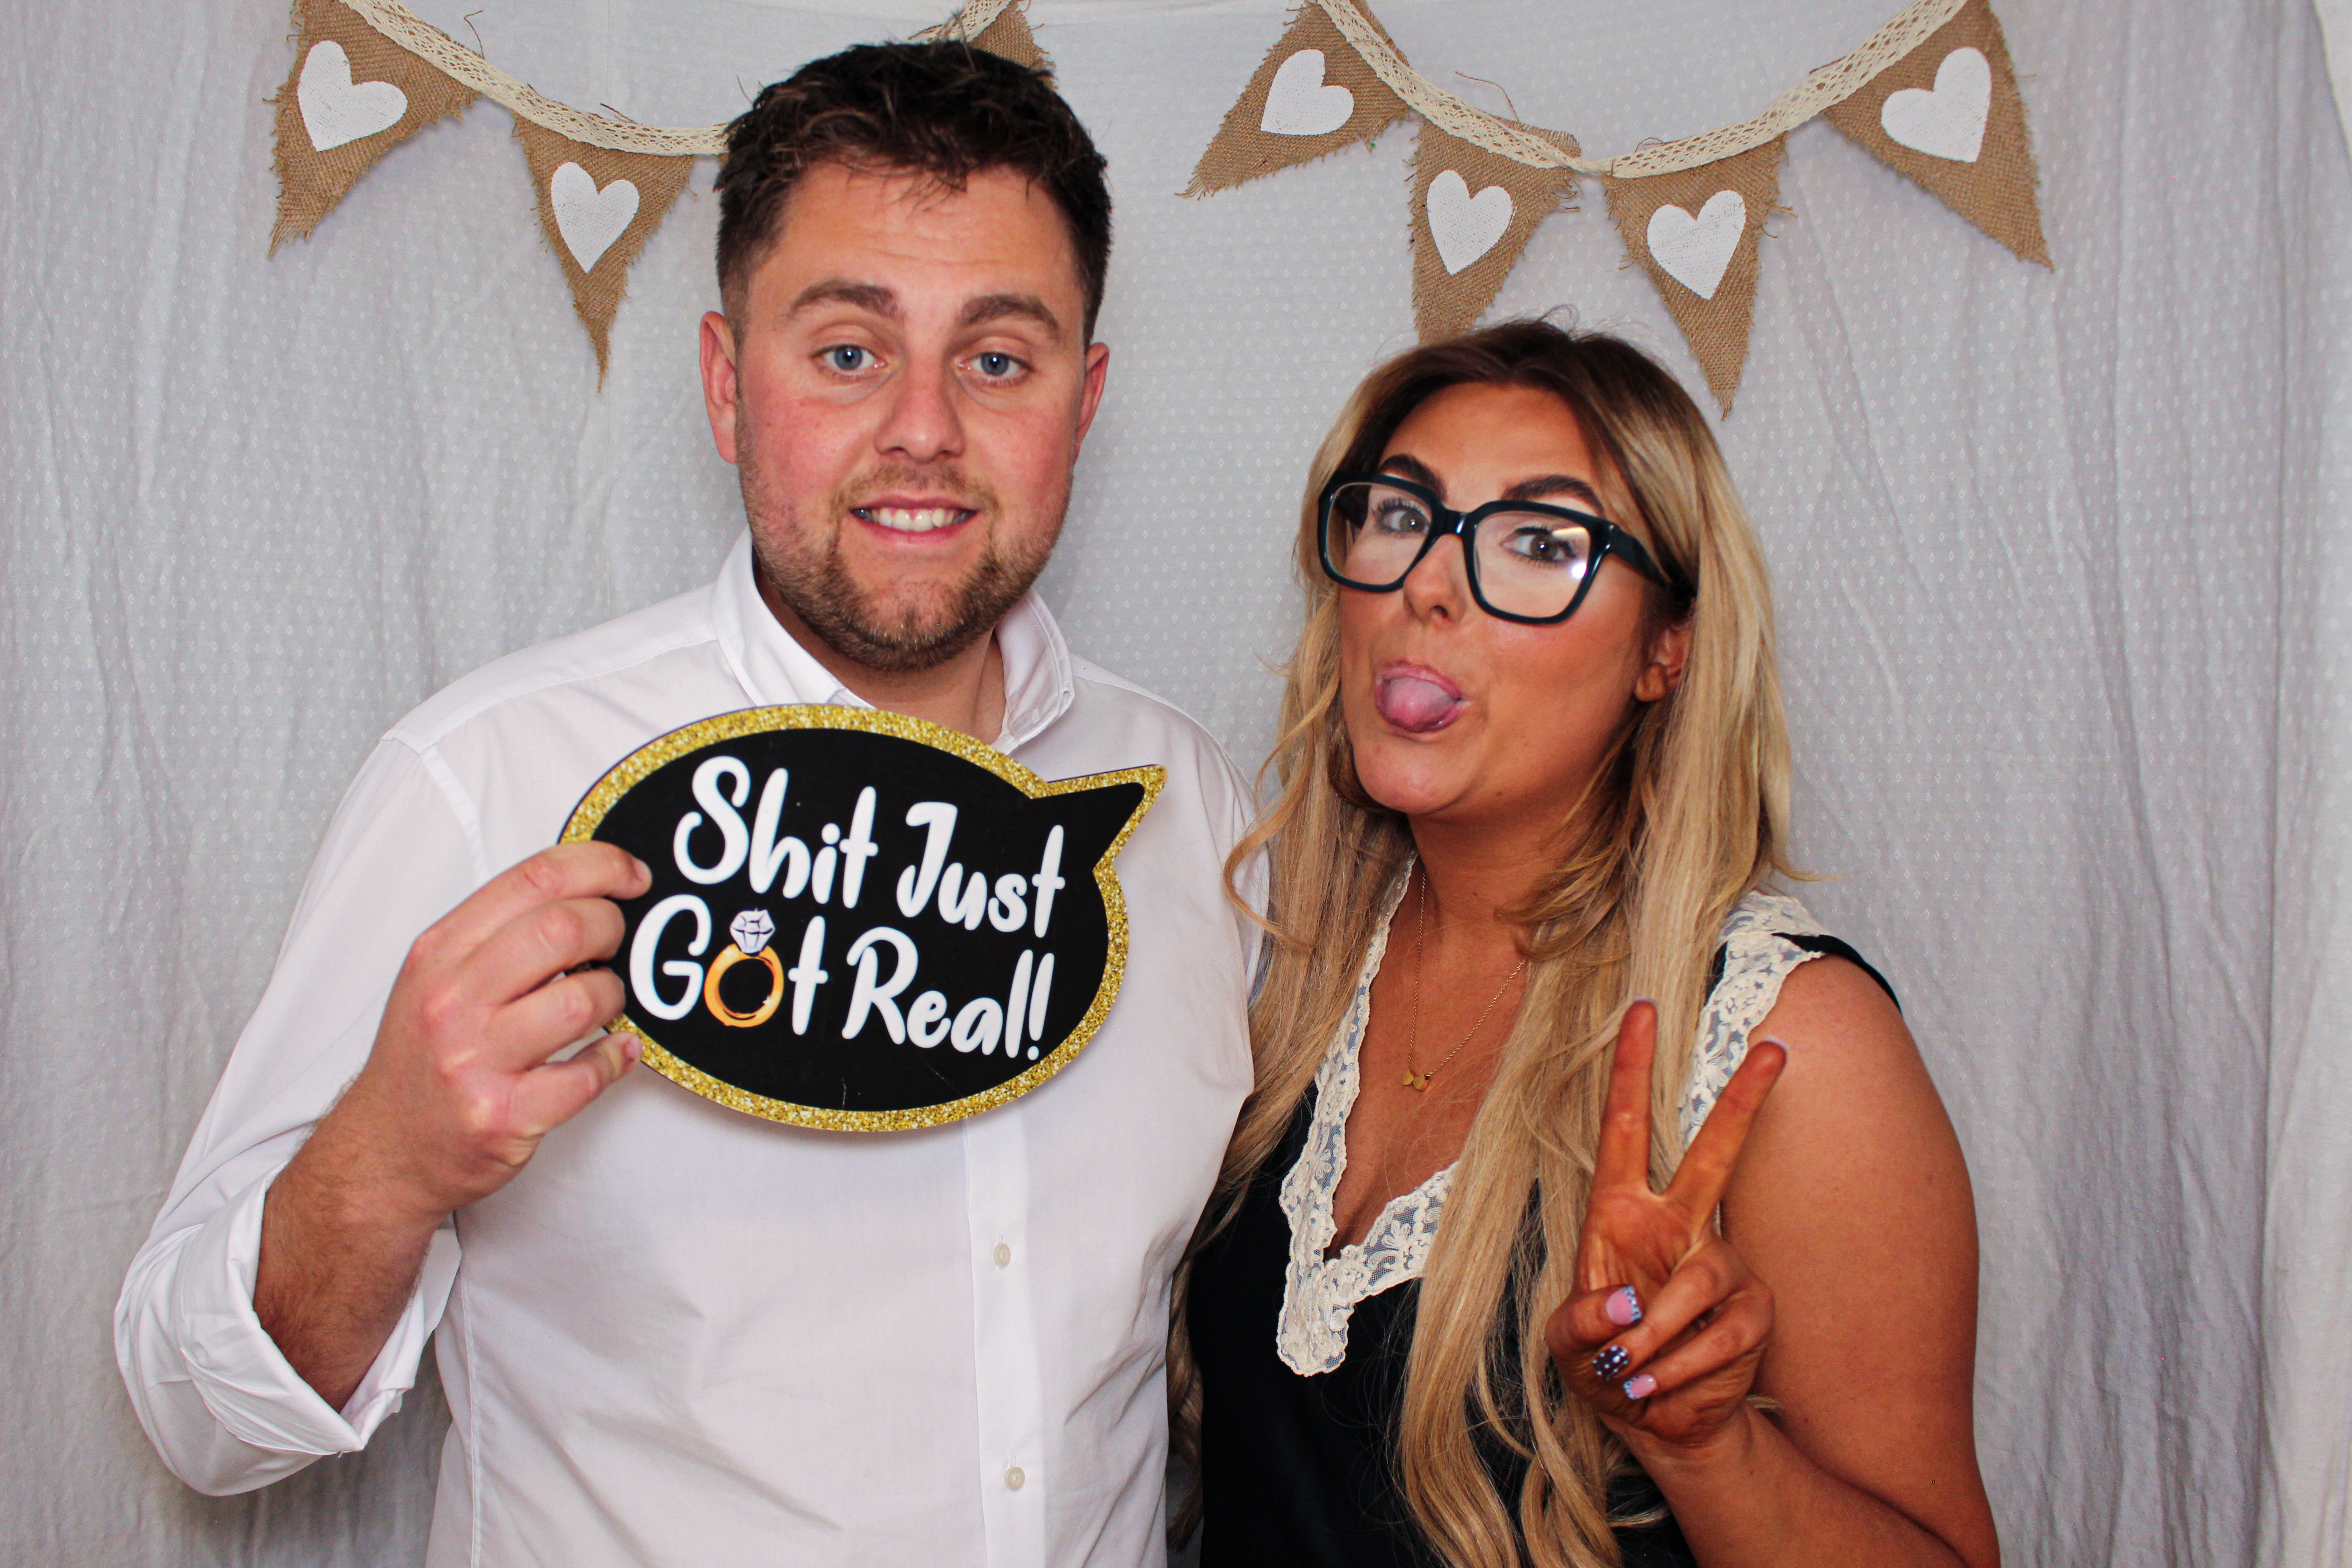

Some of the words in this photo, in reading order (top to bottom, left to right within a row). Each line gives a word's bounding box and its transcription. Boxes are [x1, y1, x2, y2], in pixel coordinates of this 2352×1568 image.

[673, 756, 879, 908] Shit
[897, 801, 1065, 938] Just
[629, 895, 828, 1035] Got
[842, 927, 1054, 1060] Real!
